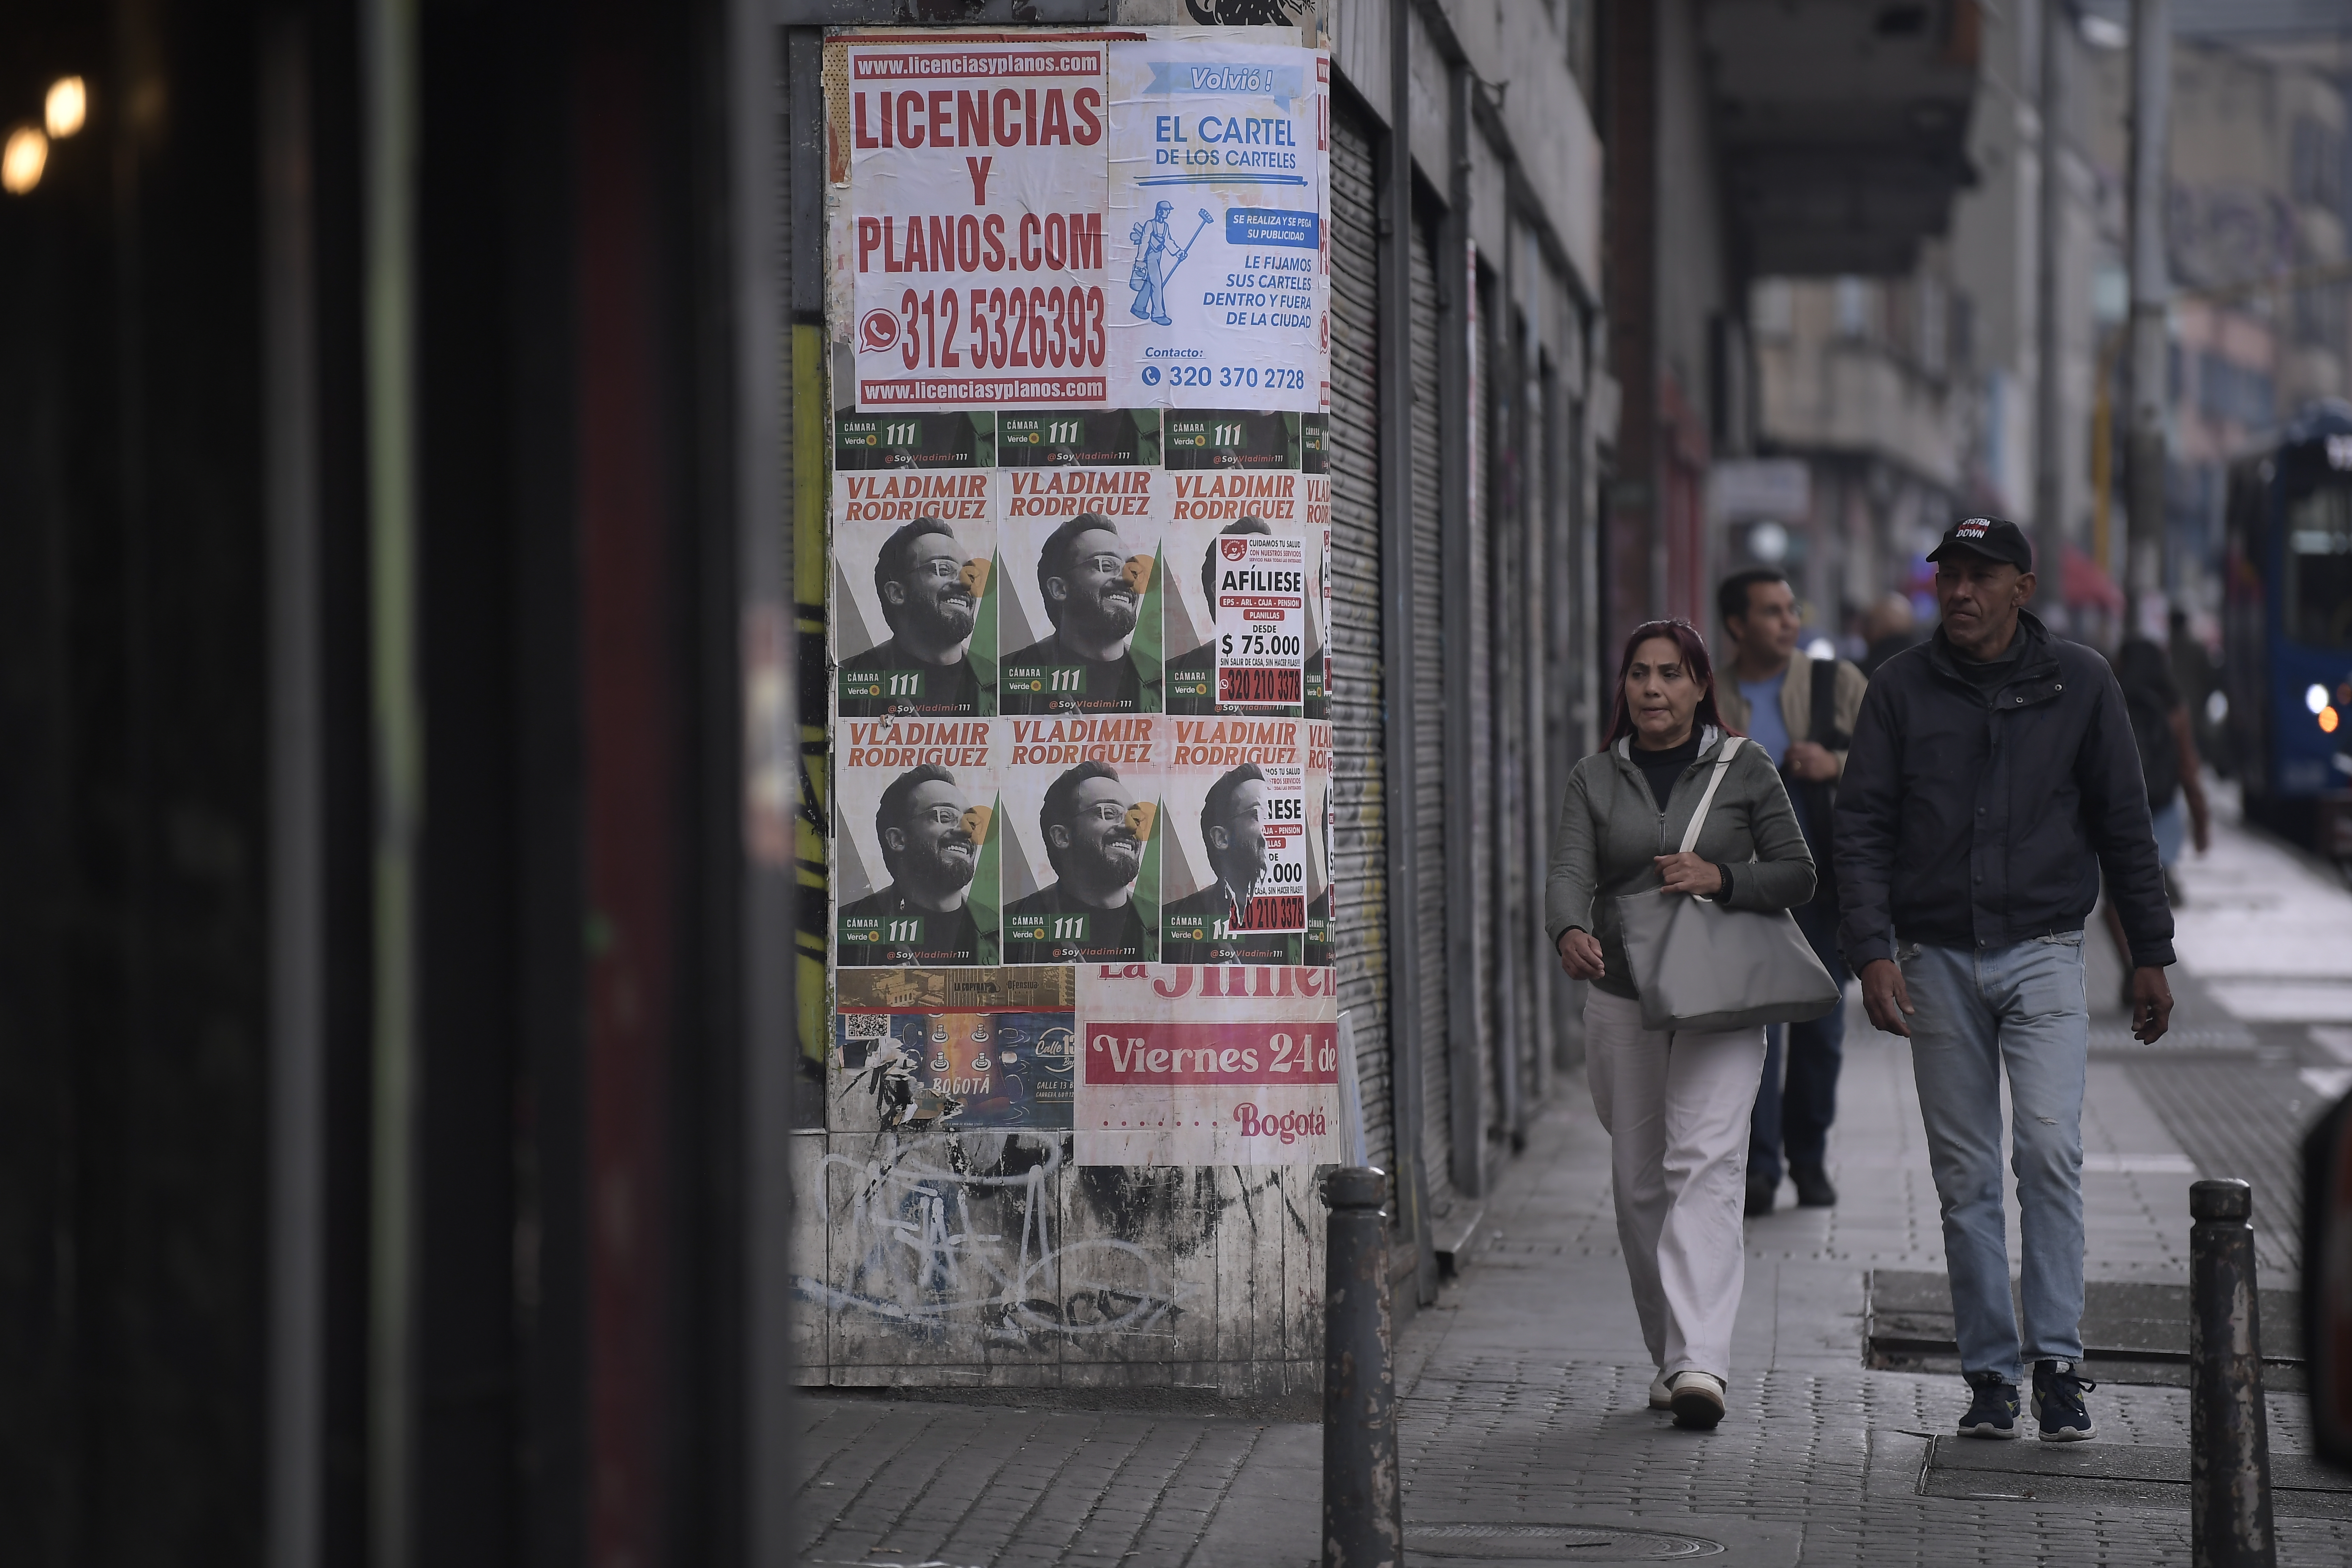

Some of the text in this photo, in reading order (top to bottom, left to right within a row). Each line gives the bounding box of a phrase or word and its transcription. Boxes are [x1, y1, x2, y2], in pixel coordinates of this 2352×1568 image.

[858, 54, 1097, 75] www.licenciasyplanos.com
[1191, 67, 1261, 91] Volvió
[854, 87, 1102, 149] LICENCIAS
[1156, 115, 1187, 142] EL
[1198, 116, 1296, 147] CARTEL
[1156, 149, 1296, 169] DE LOS CARTELES
[966, 156, 992, 206] Y
[1233, 215, 1312, 228] SE REALIZA Y SE PEGA
[858, 212, 1102, 273] PLANOS.COM
[1247, 229, 1305, 241] SU PUBLICIDAD
[1245, 255, 1312, 272] LE FIJAMOS
[1226, 274, 1312, 291] SUS CARTELES
[1203, 292, 1312, 310] DENTRO Y FUERA
[901, 286, 1105, 370] 312 5326393
[1226, 312, 1312, 329] DE LA CIUDAD
[1145, 347, 1203, 358] Contacto:
[1169, 366, 1304, 390] 320 370 2728
[865, 381, 1102, 401] www.licenciasyplanos.com
[844, 422, 876, 432] CÁMARA
[886, 423, 915, 445] 111
[1007, 420, 1039, 430] CÁMARA
[1049, 421, 1078, 443] 111
[1173, 422, 1204, 433] CÁMARA
[844, 437, 865, 445] Verde
[1007, 435, 1028, 443] Verde
[1173, 437, 1194, 445] Verde
[1214, 424, 1241, 446] 111
[885, 453, 968, 463] @SoyVladimir111
[1047, 452, 1130, 462] @SoyVladimir111
[1213, 455, 1283, 464] @SoyVladimir111
[847, 475, 987, 499] VLADIMIR
[1011, 471, 1151, 495] VLADIMIR
[1175, 475, 1295, 498] VLADIMIR
[845, 500, 987, 521] RODRIGUEZ
[1009, 496, 1151, 517] RODRIGUEZ
[1173, 500, 1295, 520] RODRIGUEZ
[1963, 518, 1990, 526] SYSTEM
[1956, 529, 1985, 539] DOWN
[1221, 564, 1301, 592] AFÍLIESE
[1278, 598, 1299, 607] PENSIÓN
[1222, 633, 1299, 657] $ 75.000
[1230, 658, 1244, 666] SALIR
[1252, 659, 1265, 667] CASA,
[847, 672, 879, 682] CÁMARA
[1009, 667, 1040, 677] CÁMARA
[1051, 669, 1081, 691] 111
[1174, 671, 1206, 681] CÁMARA
[847, 687, 868, 695] Verde
[890, 673, 919, 695] 111
[1174, 686, 1195, 694] Verde
[1228, 670, 1250, 700] 320
[1254, 670, 1274, 700] 210
[1278, 671, 1299, 700] 3378
[888, 703, 971, 713] @SoyVladimir111
[1049, 700, 1132, 709] @SoyVladimir111
[849, 722, 990, 745] VLADIMIR
[1013, 719, 1153, 743] VLADIMIR
[1176, 721, 1296, 745] VLADIMIR
[847, 747, 989, 767] RODRIGUEZ
[1011, 743, 1153, 765] RODRIGUEZ
[1173, 746, 1296, 765] RODRIGUEZ
[1279, 825, 1300, 834] PENSIÓN
[1277, 886, 1289, 894] HACER
[1013, 915, 1044, 926] CÁMARA
[1171, 915, 1202, 926] CÁMARA
[1257, 898, 1277, 928] 210
[1281, 898, 1304, 927] 3378
[847, 917, 879, 928] CÁMARA
[889, 920, 918, 942] 111
[1054, 917, 1083, 939] 111
[887, 951, 969, 960] @SoyVladimir111
[1053, 947, 1136, 957] @SoyVladimir111
[1210, 950, 1283, 959] @SoyVladimir111
[1035, 1040, 1062, 1055] Calle
[1092, 1033, 1336, 1073] Viernes 24 de
[933, 1075, 990, 1095] BOGOTÁ
[1233, 1102, 1326, 1144] Bogotá
